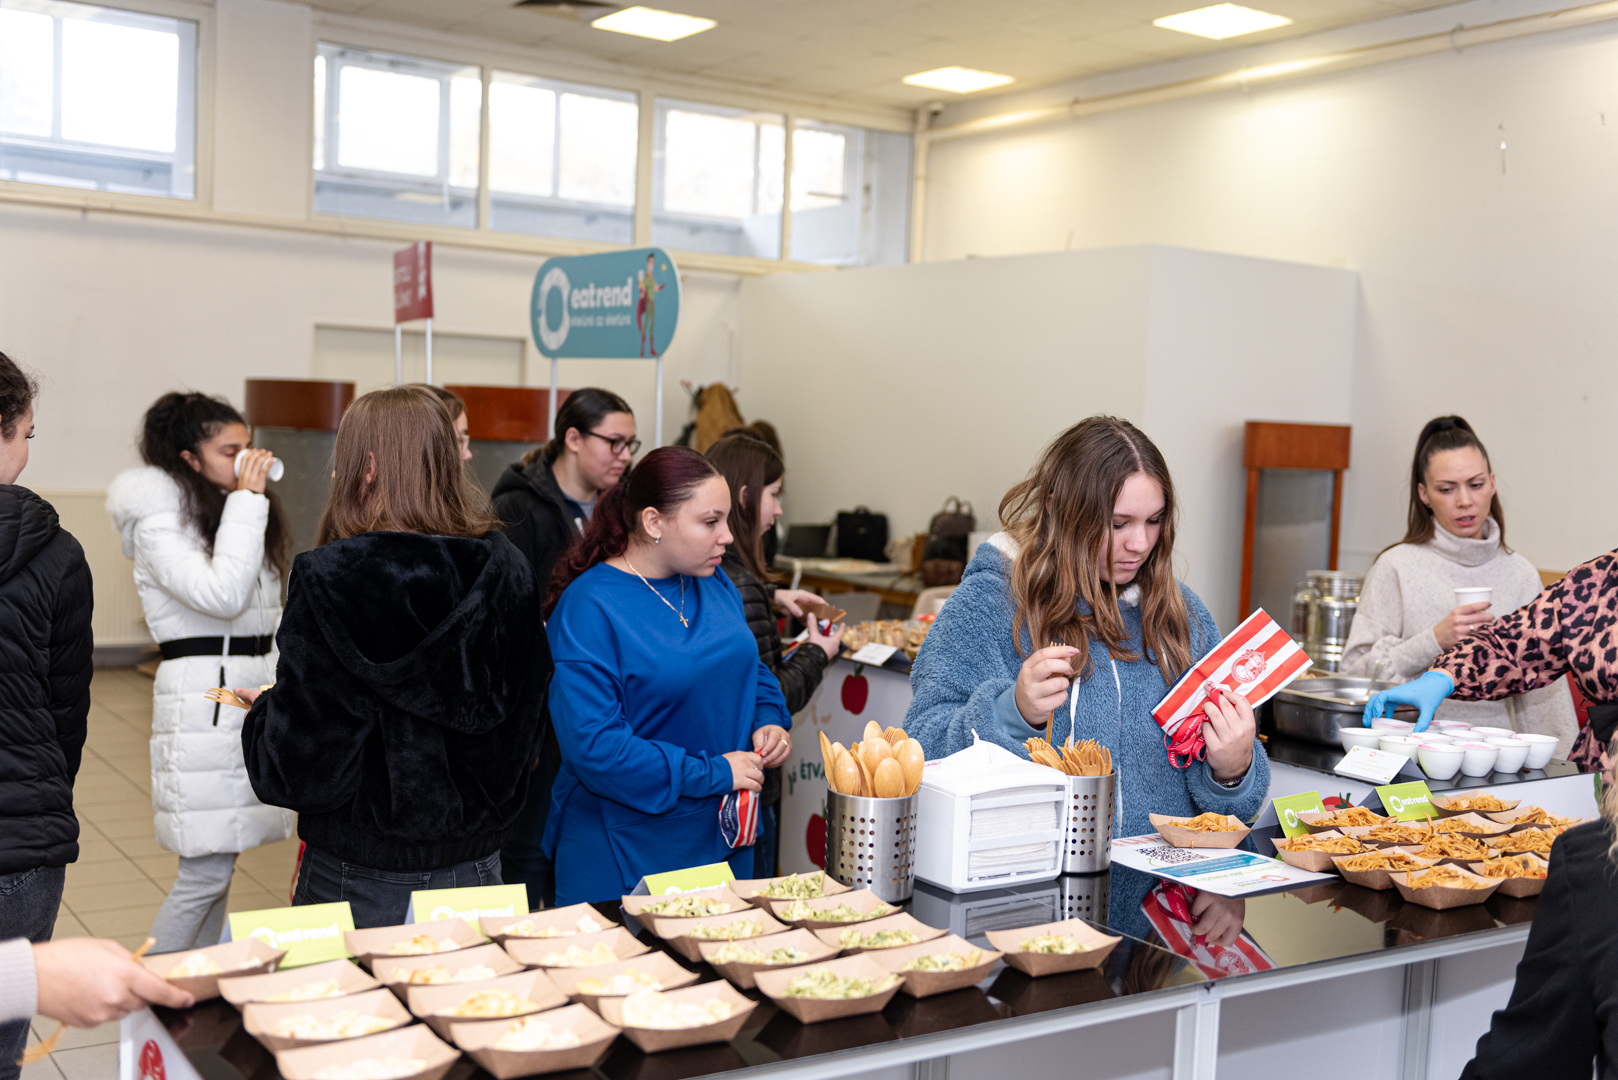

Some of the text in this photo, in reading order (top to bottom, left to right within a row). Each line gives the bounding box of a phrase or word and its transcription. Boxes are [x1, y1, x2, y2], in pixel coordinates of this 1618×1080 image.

[571, 276, 632, 309] eatrend
[1401, 794, 1429, 806] eatrend
[276, 922, 340, 943] eatrend
